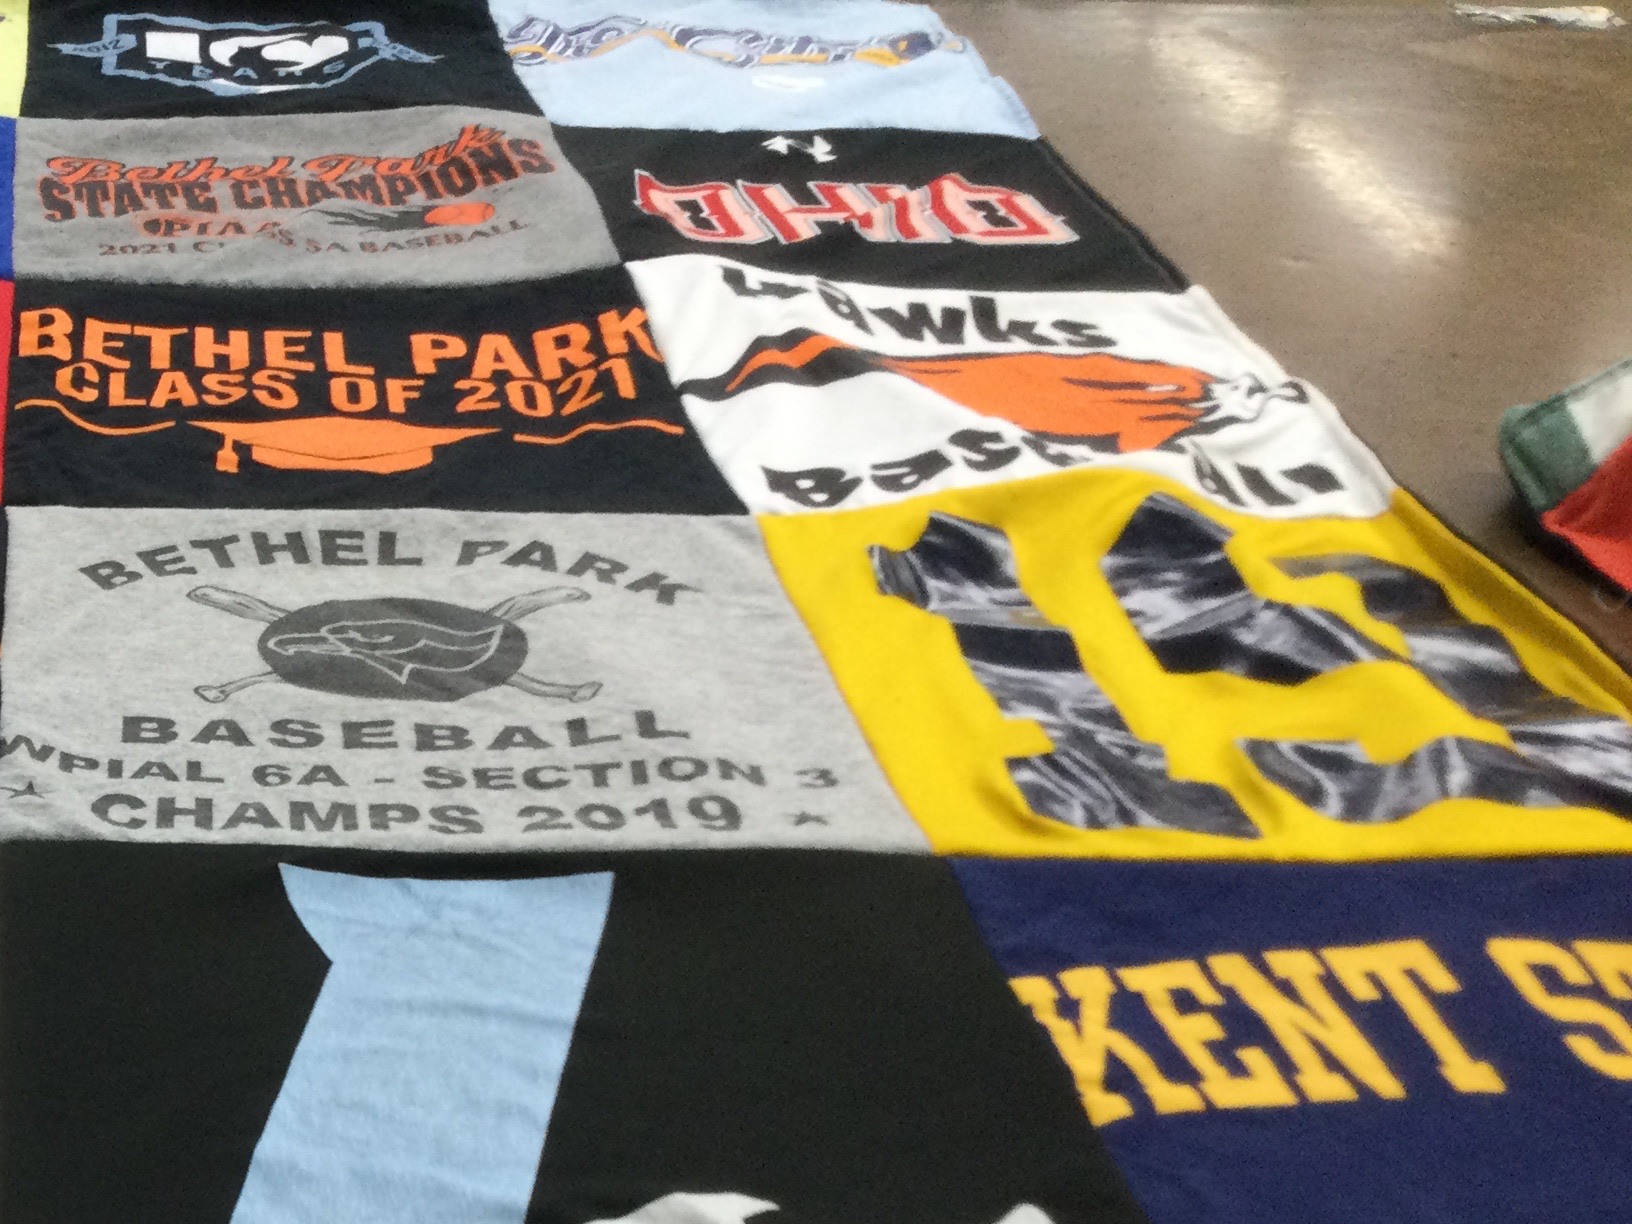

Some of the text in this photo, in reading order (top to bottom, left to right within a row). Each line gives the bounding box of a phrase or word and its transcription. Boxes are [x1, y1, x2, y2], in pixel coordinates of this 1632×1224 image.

[38, 137, 556, 222] STATE CHAMPIONS
[45, 156, 294, 184] Bethel
[18, 305, 667, 382] BETHEL PARK
[55, 357, 638, 418] CLASS OF 2021
[78, 529, 703, 607] BETHEL PARK
[120, 708, 692, 752] BASEBALL
[0, 734, 226, 784] WPIAL
[251, 762, 352, 788] 6A
[421, 755, 768, 791] SECTION
[794, 768, 841, 788] 3
[90, 792, 744, 837] CHAMPS 2019
[1009, 938, 1506, 1128] KENT
